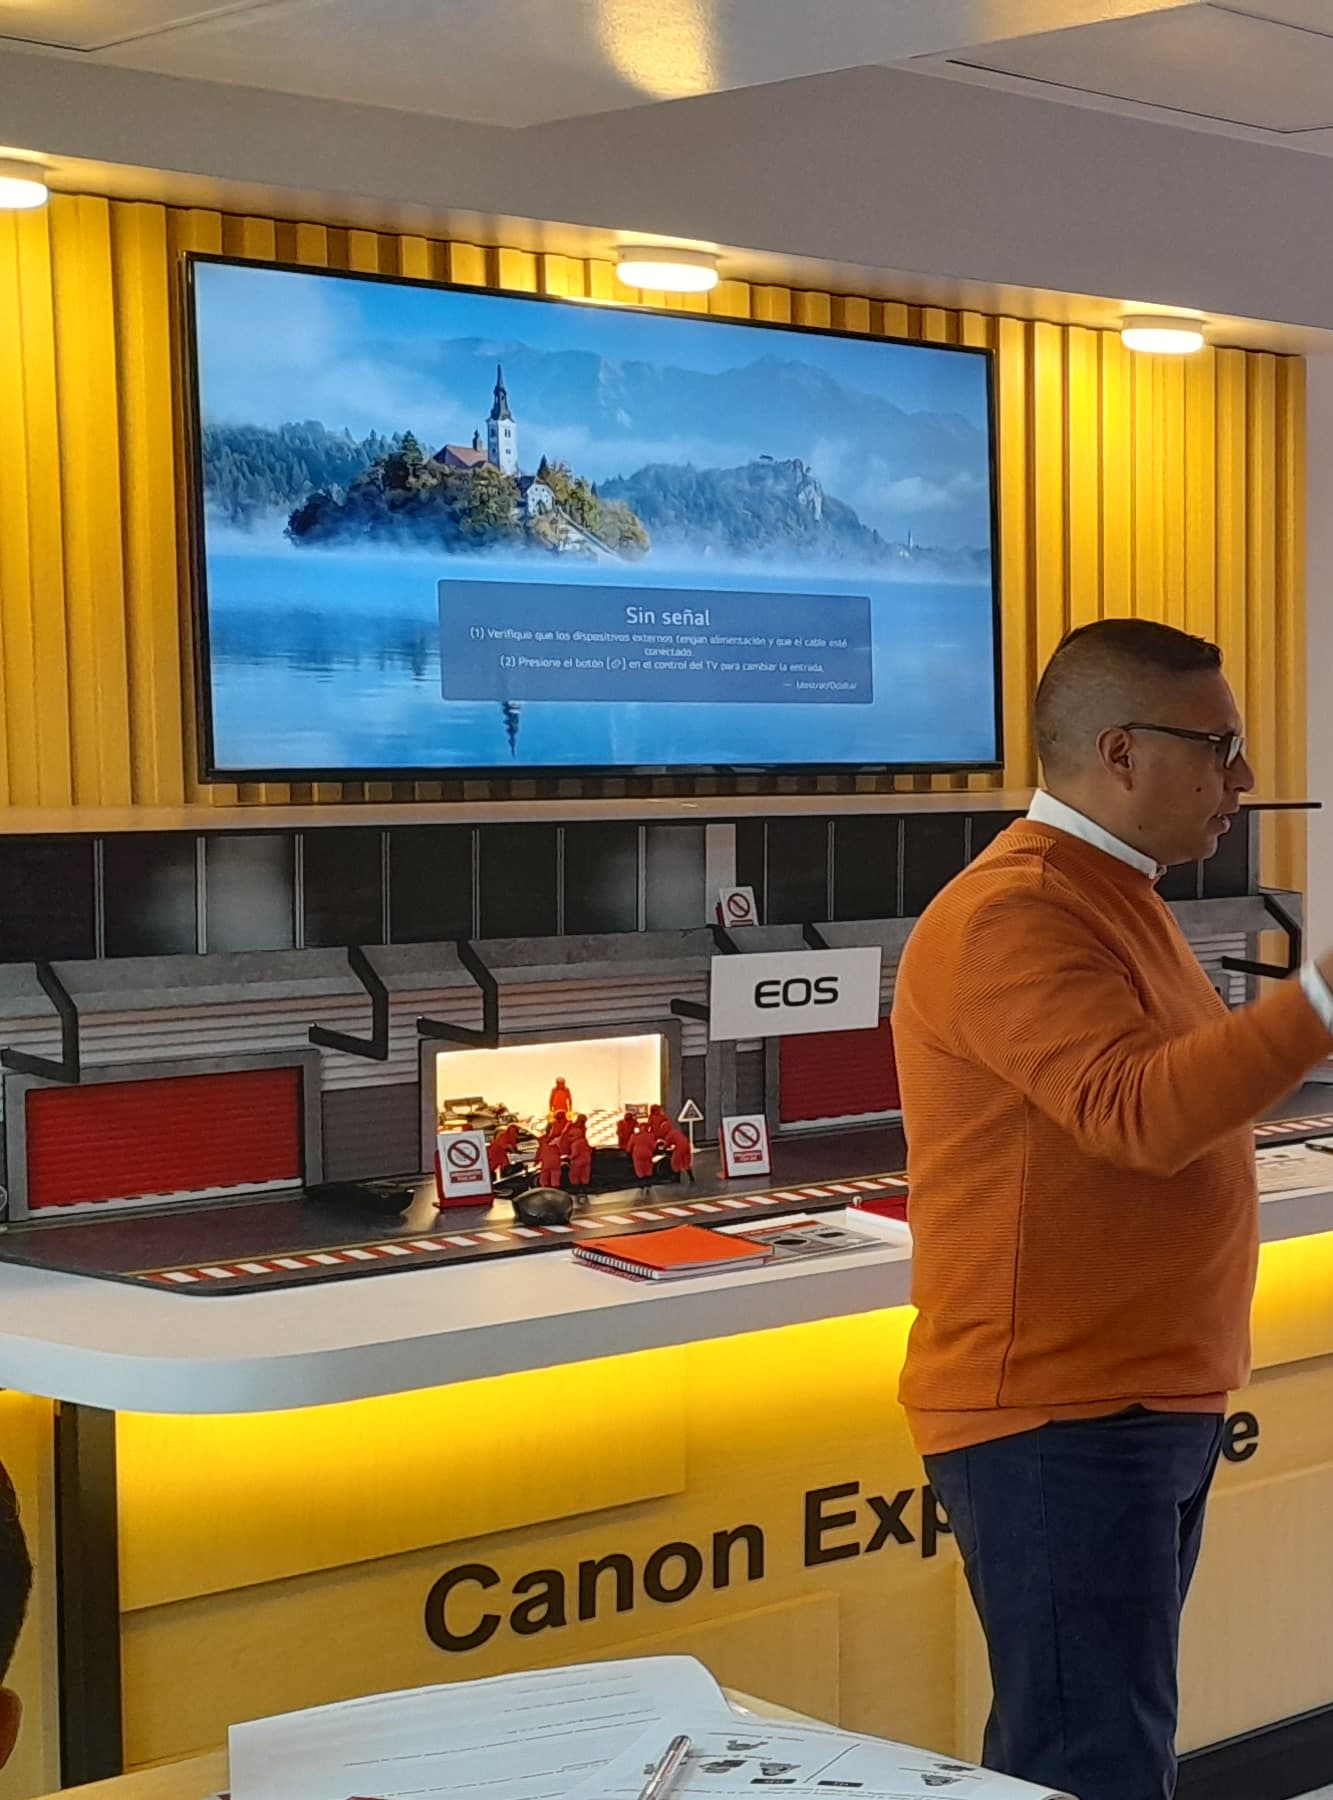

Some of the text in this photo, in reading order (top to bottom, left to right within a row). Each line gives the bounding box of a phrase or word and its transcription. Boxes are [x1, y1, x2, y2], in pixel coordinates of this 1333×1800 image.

[625, 606, 711, 627] Sin señal
[470, 626, 485, 640] (1)
[487, 628, 532, 642] Verifique
[534, 631, 553, 643] que
[556, 630, 571, 641] los
[573, 630, 631, 644] dispositivos
[500, 654, 516, 668] (2)
[518, 655, 561, 668] Presione
[563, 657, 573, 668] el
[575, 657, 604, 669] botón
[628, 660, 641, 669] en
[706, 661, 719, 671] TV
[720, 663, 740, 673] para
[753, 975, 840, 1010] EOS
[423, 1523, 766, 1654] Canon
